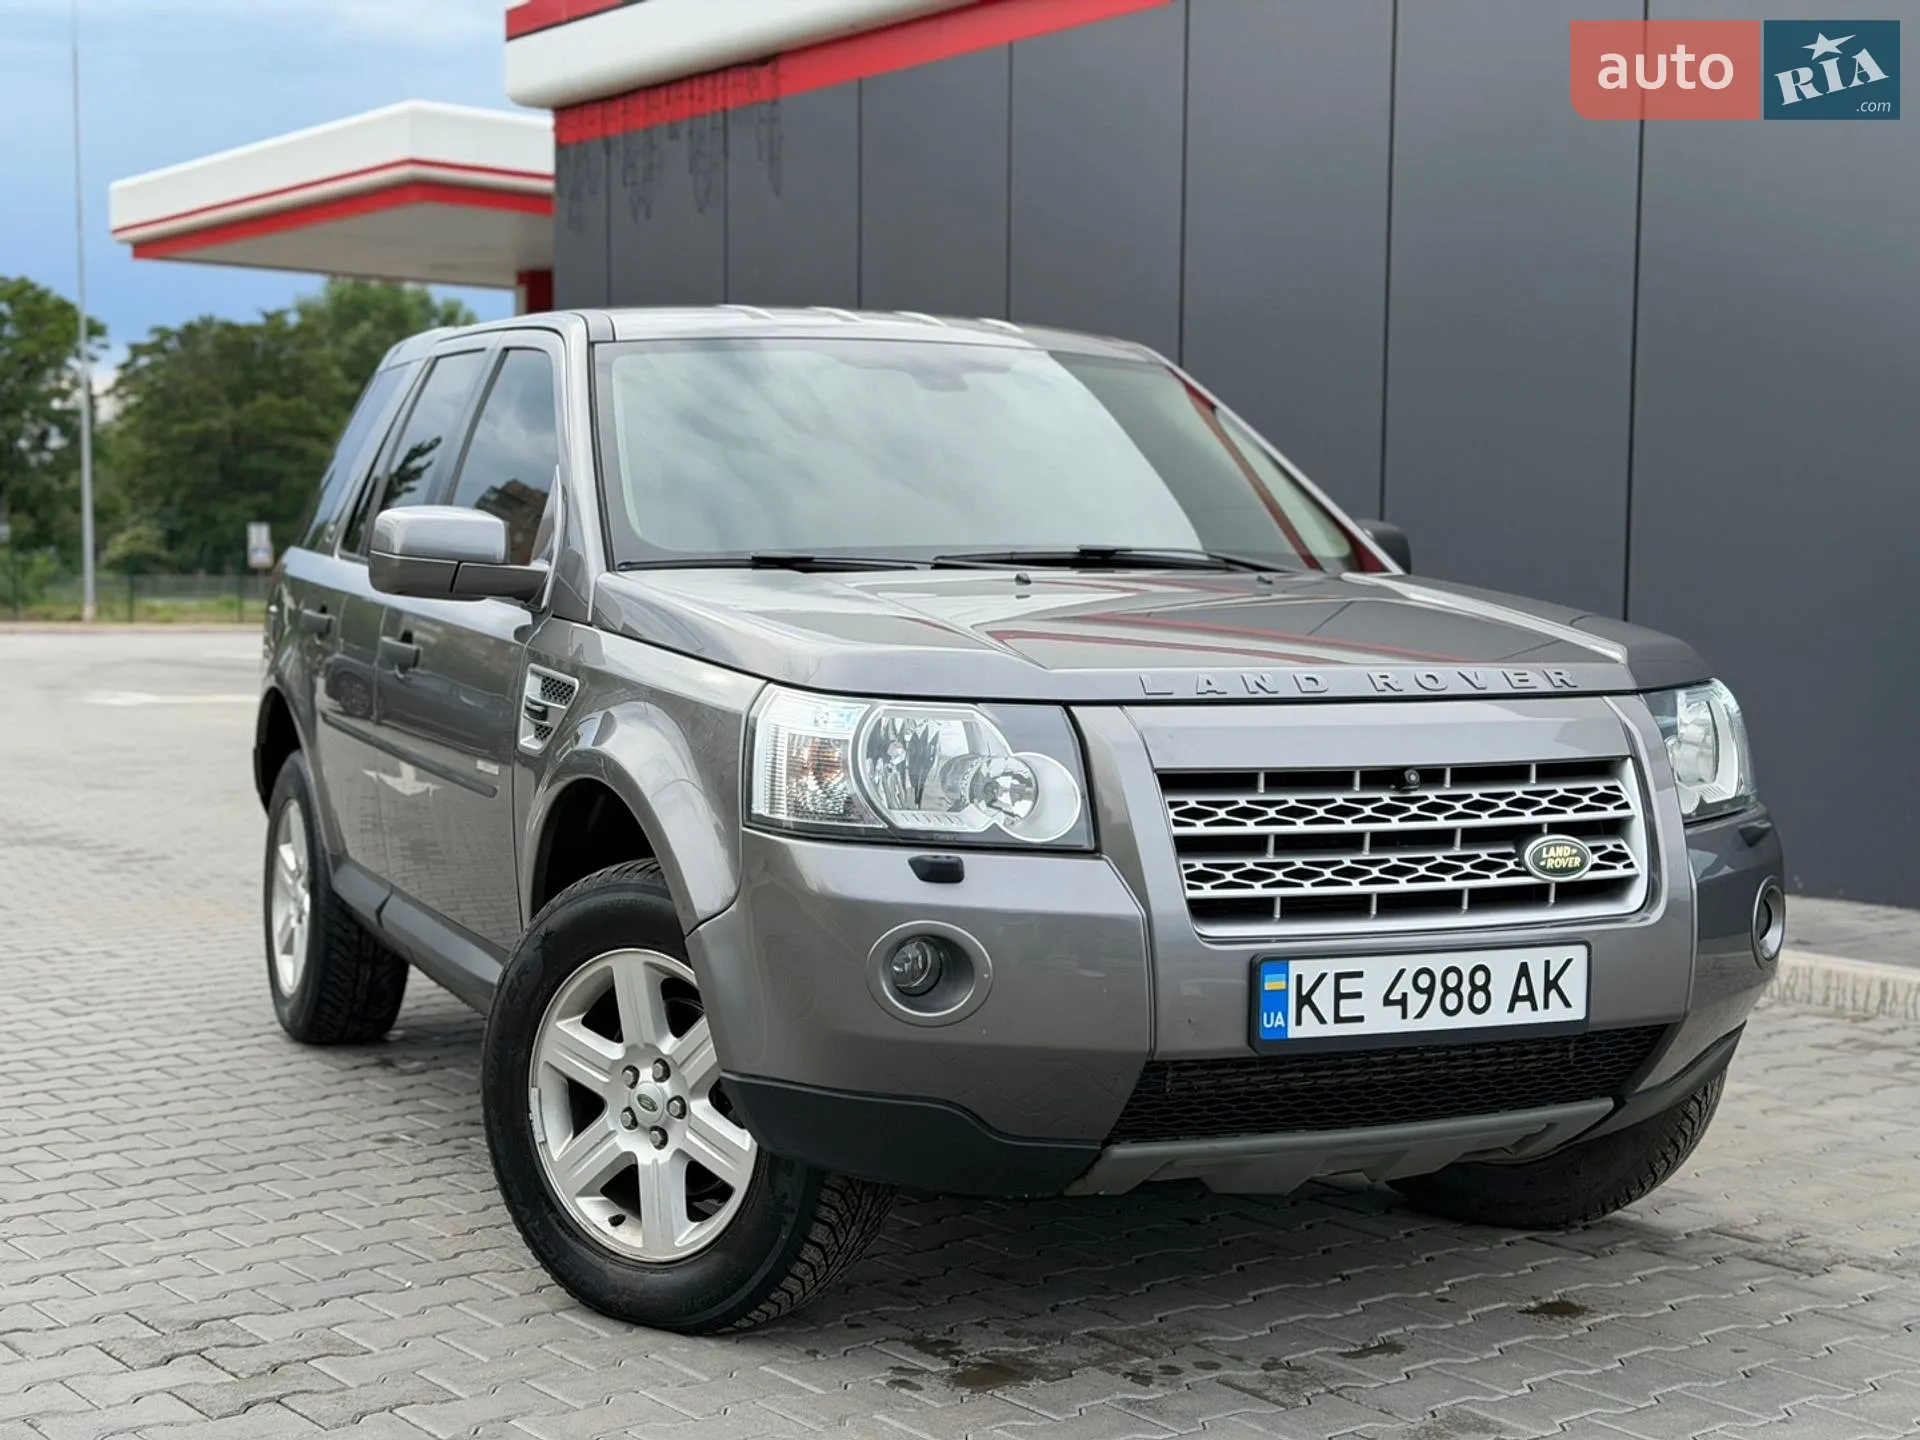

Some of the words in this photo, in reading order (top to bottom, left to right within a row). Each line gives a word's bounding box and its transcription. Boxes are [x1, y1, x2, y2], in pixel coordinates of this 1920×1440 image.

[1138, 672, 1329, 696] LAND
[1367, 668, 1578, 692] ROVER
[1542, 845, 1571, 858] LAND
[1546, 856, 1581, 869] ROVER
[1295, 970, 1365, 1027] KE
[1382, 963, 1492, 1020] 4988
[1506, 957, 1574, 1014] AK
[1263, 1012, 1286, 1029] UA
